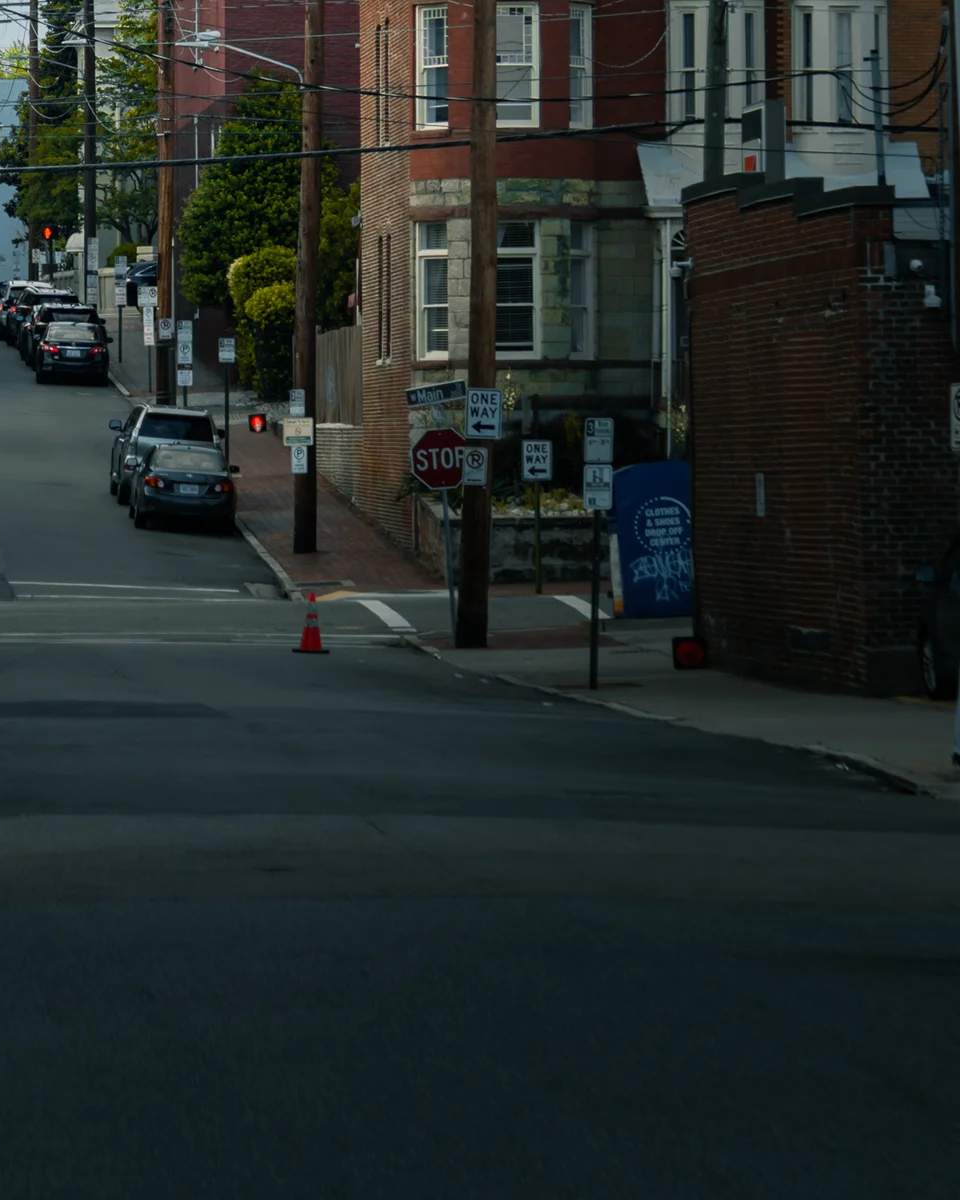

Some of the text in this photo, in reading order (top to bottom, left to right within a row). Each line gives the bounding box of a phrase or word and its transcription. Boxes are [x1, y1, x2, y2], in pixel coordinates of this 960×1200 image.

[417, 388, 444, 403] Main
[471, 393, 497, 405] ONE
[470, 407, 497, 418] WAY
[587, 422, 594, 434] 3
[526, 444, 547, 453] ONE
[416, 446, 465, 471] STOP
[526, 454, 547, 464] WAY
[645, 507, 680, 516] CLOTHES
[646, 517, 680, 527] & SHOES
[645, 526, 683, 537] DROP OFF
[650, 537, 681, 547] CENTER
